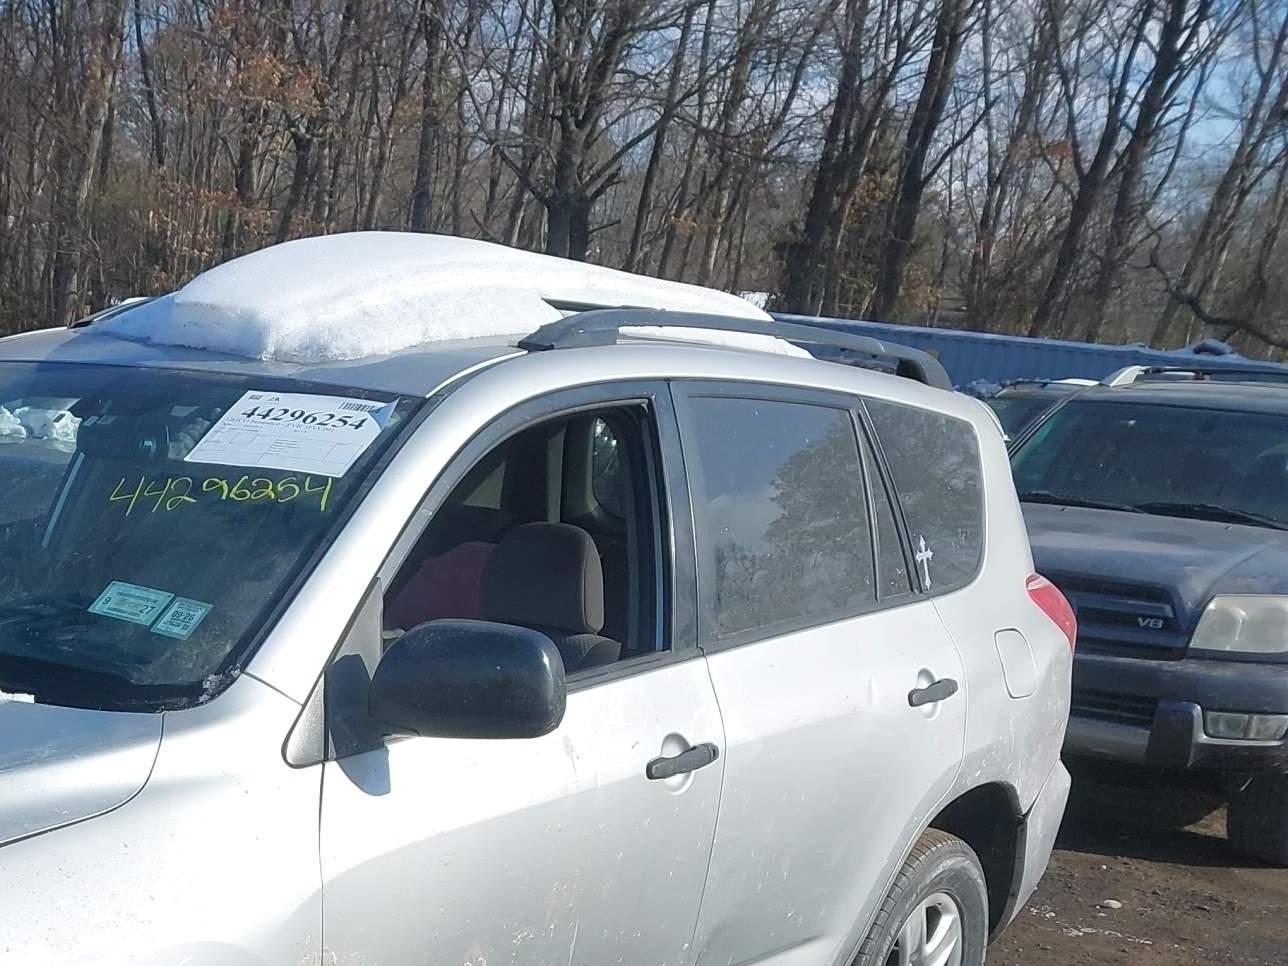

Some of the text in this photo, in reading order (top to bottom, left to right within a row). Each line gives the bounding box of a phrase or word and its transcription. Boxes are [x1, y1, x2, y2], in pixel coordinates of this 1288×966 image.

[241, 405, 369, 430] 44296254
[109, 475, 333, 517] 44296254
[101, 596, 112, 605] 9
[139, 604, 156, 615] 27
[1137, 616, 1164, 629] V8
